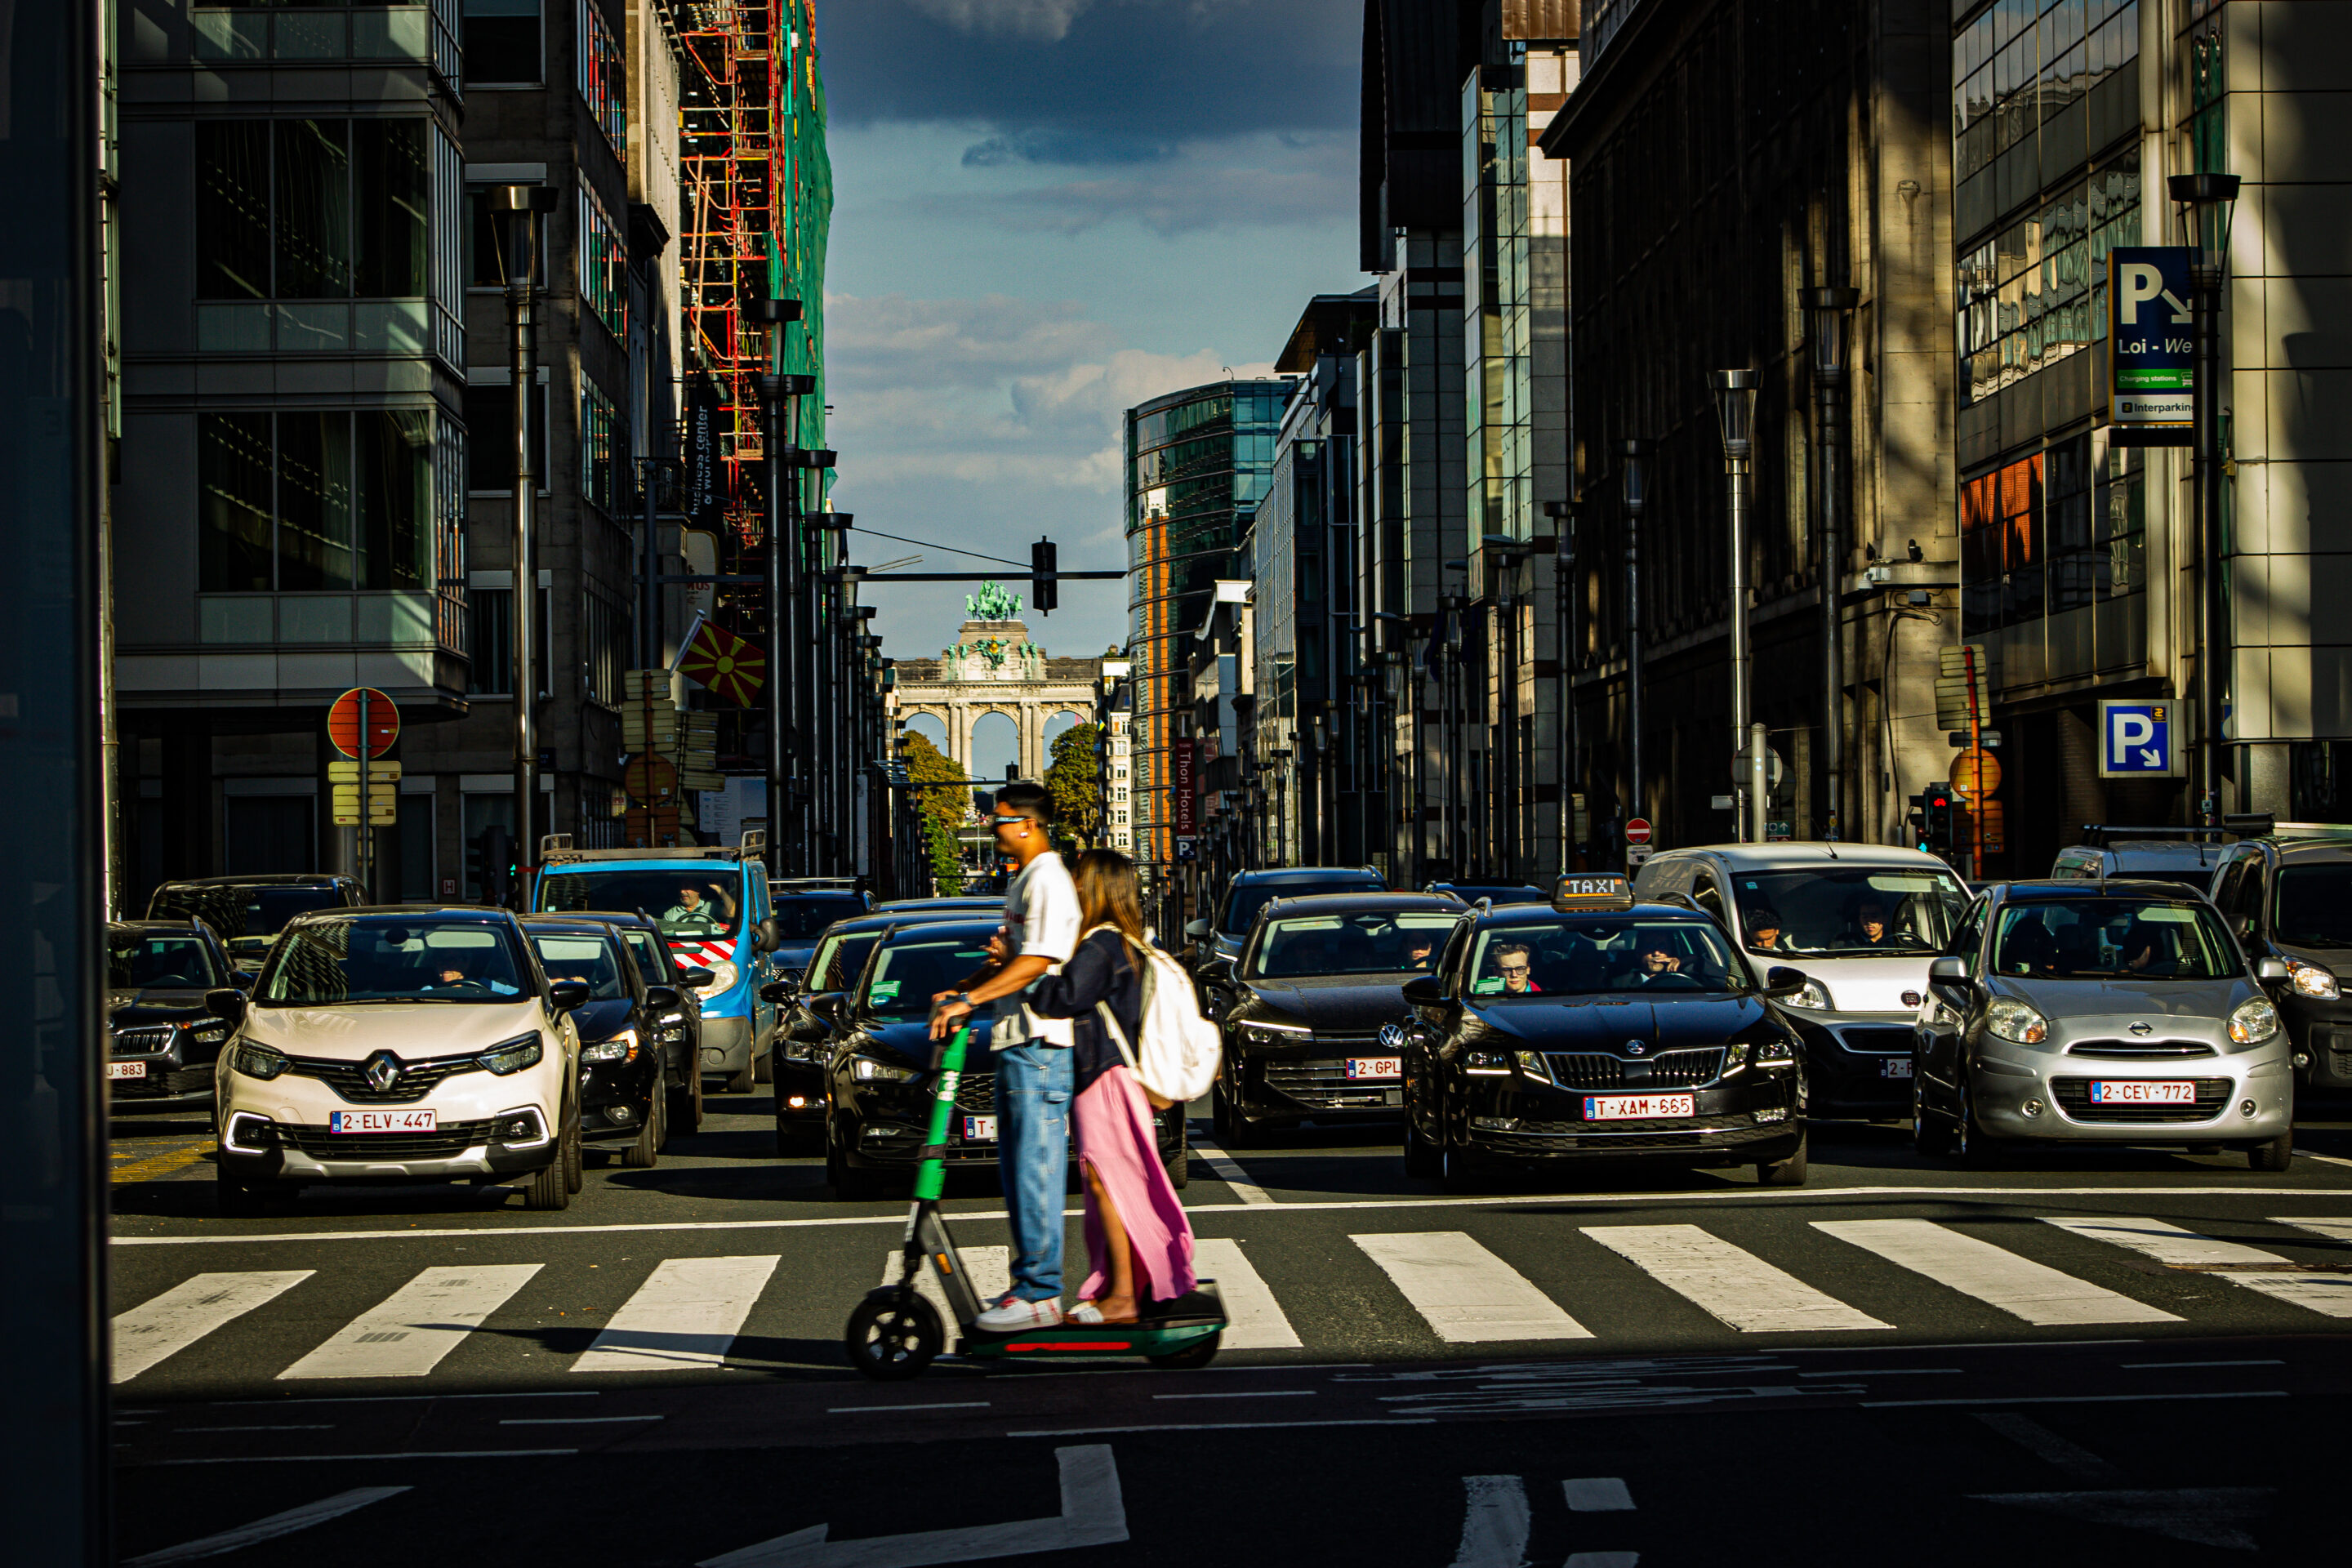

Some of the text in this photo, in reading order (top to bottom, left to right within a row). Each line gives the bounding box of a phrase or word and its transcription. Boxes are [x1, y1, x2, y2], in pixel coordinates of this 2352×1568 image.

[2120, 263, 2163, 324] P
[2118, 337, 2146, 354] Loi
[2119, 375, 2149, 383] Charging
[690, 405, 708, 515] business center
[2114, 713, 2154, 764] P
[1179, 752, 1192, 784] Thon
[1180, 789, 1192, 830] Hotels
[1178, 841, 1190, 856] P
[445, 881, 453, 893] H
[1570, 880, 1615, 893] TAXI
[343, 1112, 433, 1129] 2-ELV-447
[967, 1128, 973, 1136] B
